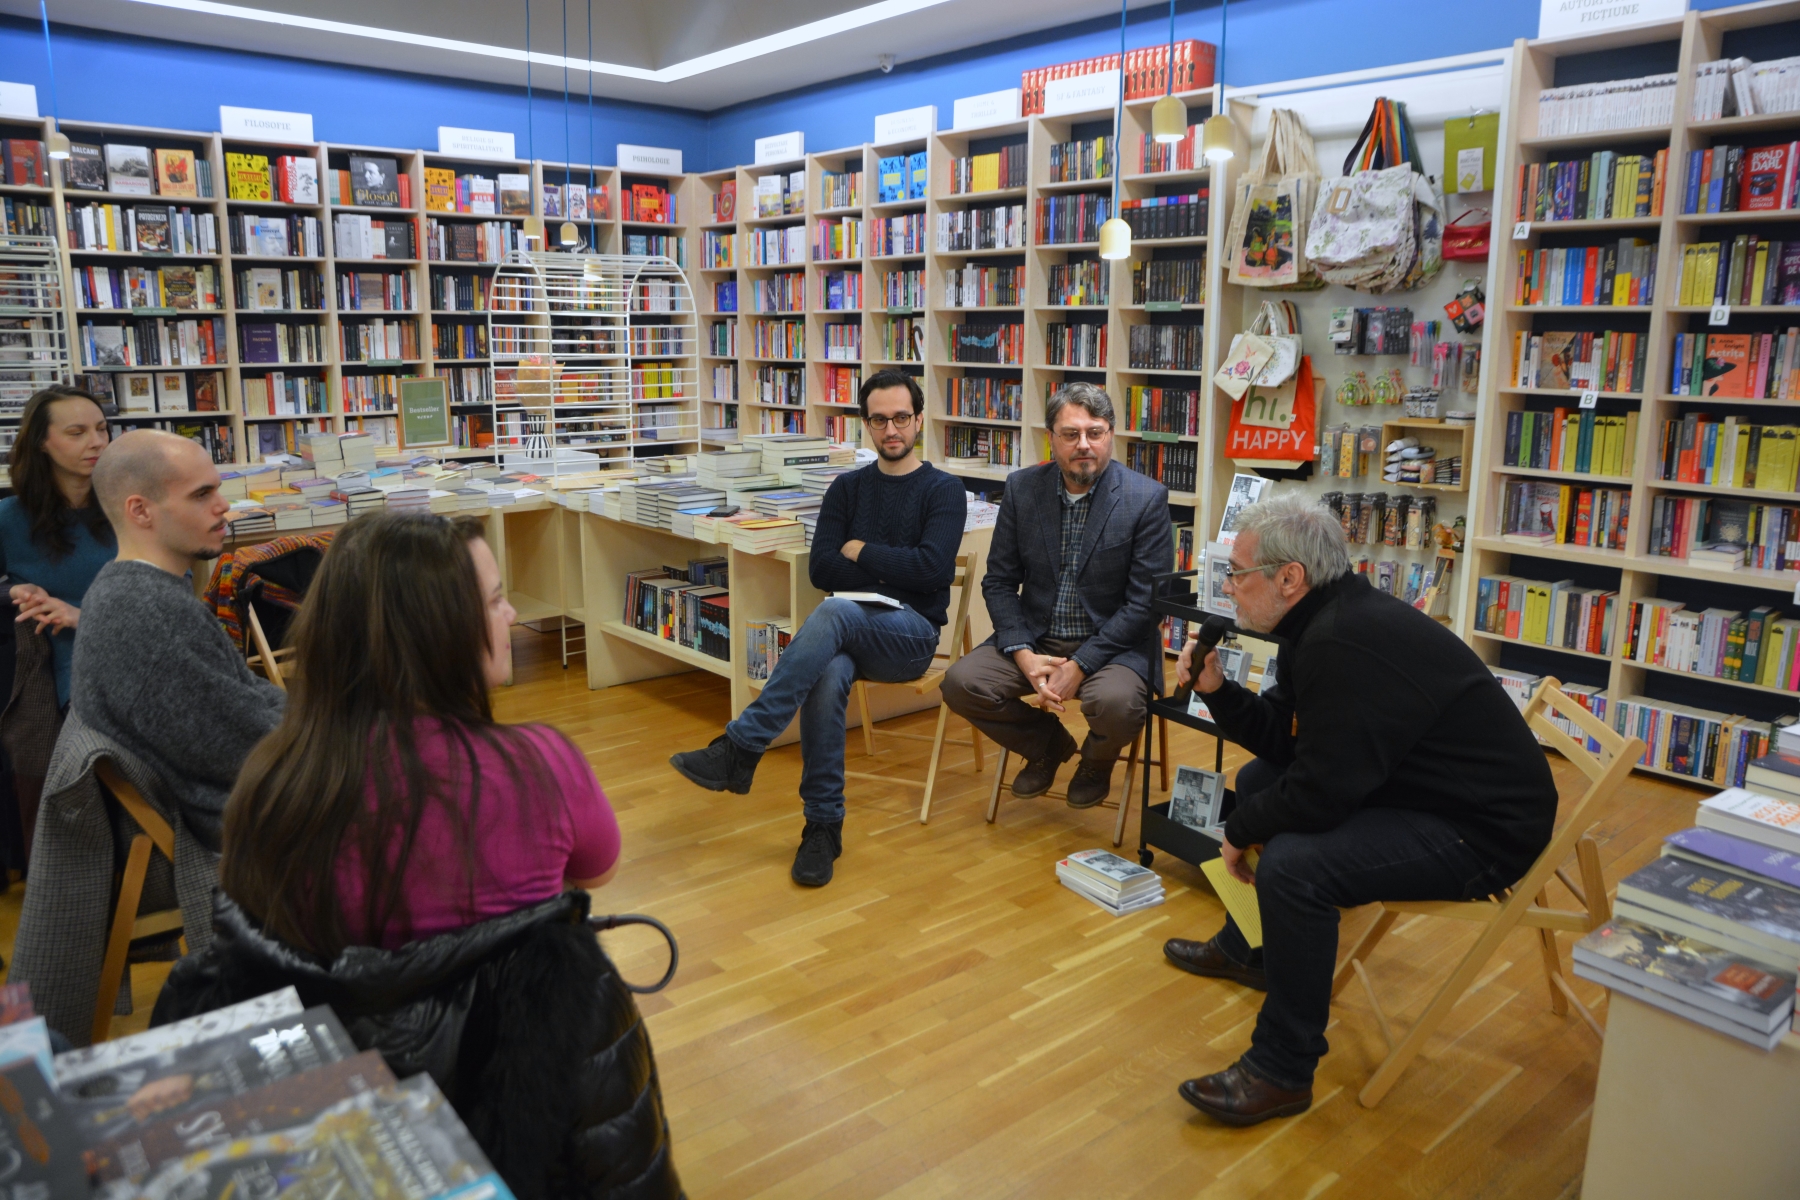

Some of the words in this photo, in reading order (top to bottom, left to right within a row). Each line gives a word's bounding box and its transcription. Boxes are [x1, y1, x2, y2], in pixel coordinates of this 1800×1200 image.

[1580, 4, 1640, 22] FICȚIUNE
[1072, 86, 1106, 98] FANTASY
[244, 118, 291, 130] FILOSOFIE
[72, 145, 99, 157] BALCANII
[452, 142, 504, 153] SPIRITUALITATE
[632, 154, 670, 165] PSIHOLOGIE
[1752, 149, 1784, 161] ROALD
[1750, 159, 1782, 172] DAHL
[1516, 224, 1526, 236] A
[1714, 309, 1726, 322] D
[1584, 394, 1594, 404] B
[1232, 430, 1307, 450] HAPPY
[1198, 708, 1208, 718] BOX
